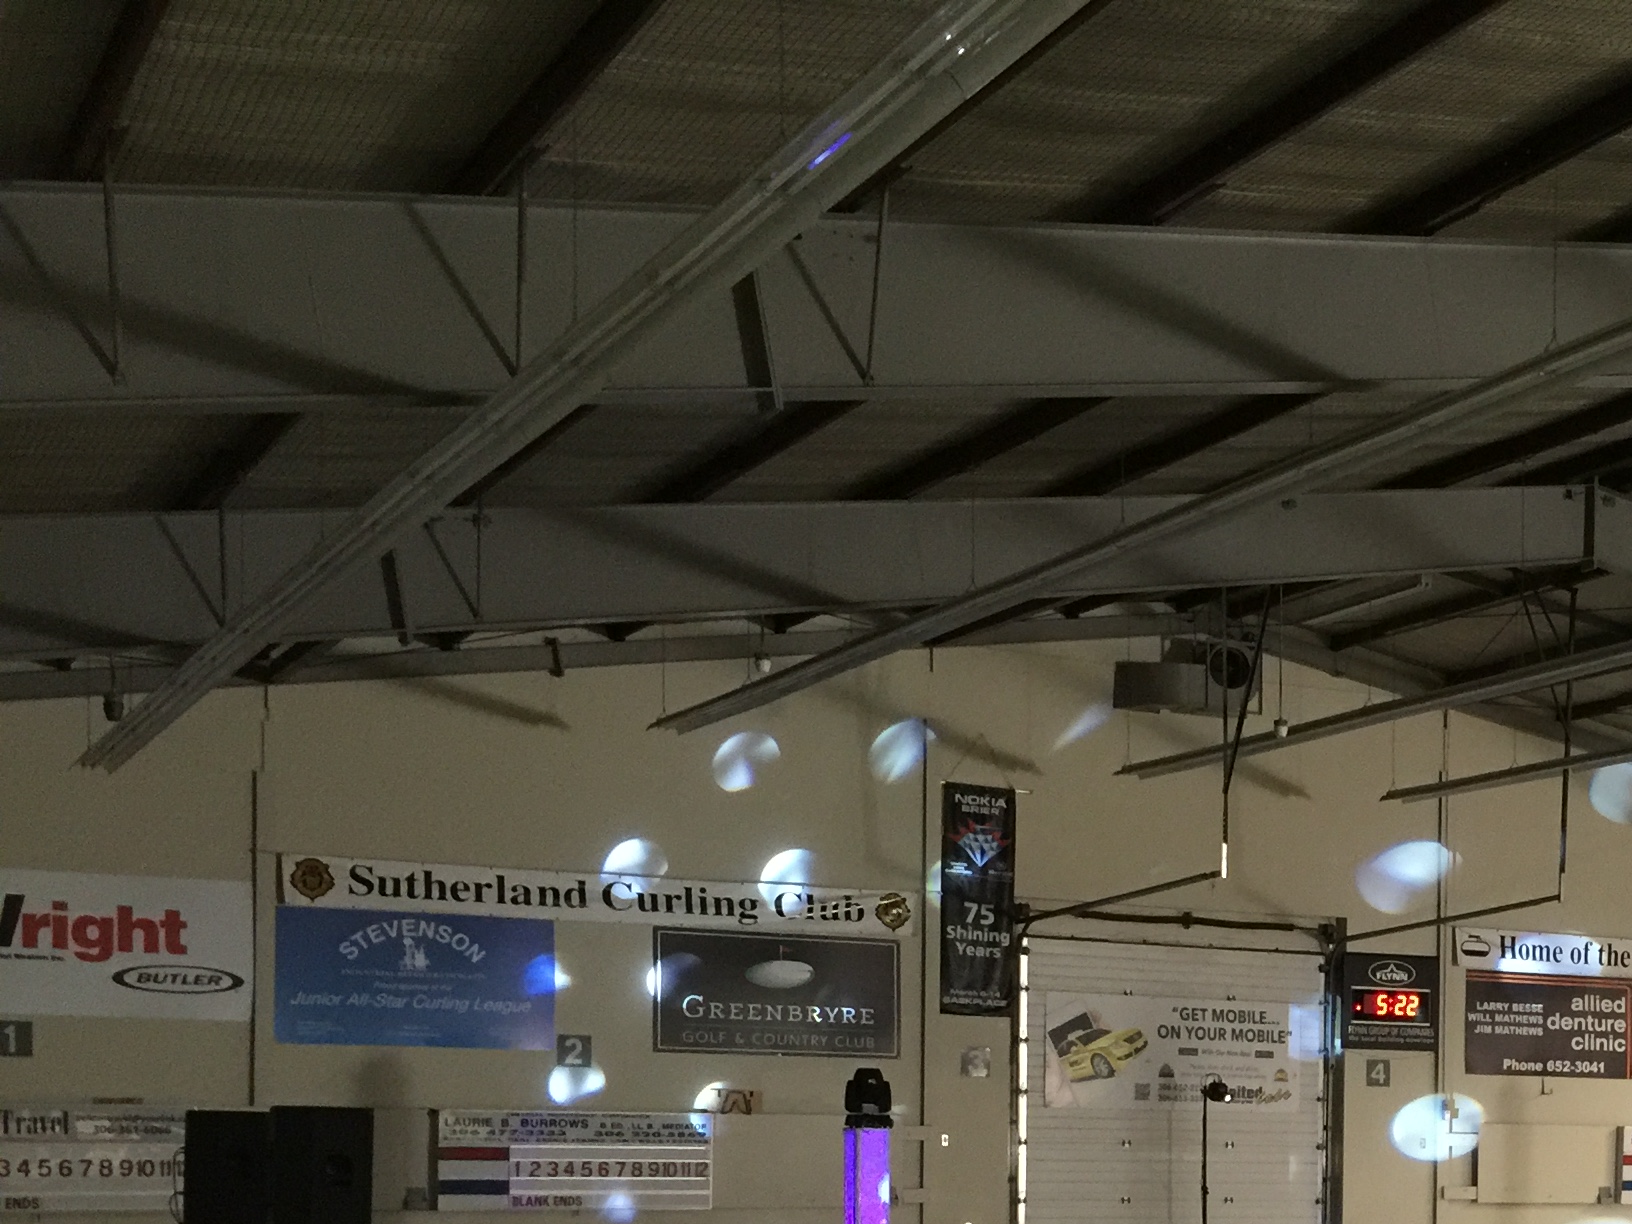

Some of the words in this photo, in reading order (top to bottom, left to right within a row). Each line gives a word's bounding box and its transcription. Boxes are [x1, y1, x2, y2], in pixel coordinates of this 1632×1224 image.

[955, 794, 1007, 808] NOKIA
[962, 805, 1000, 816] BRIER
[348, 864, 588, 909] Sutherland
[601, 881, 759, 925] Curling
[773, 891, 866, 923] Club
[964, 901, 995, 925] 75
[339, 919, 487, 963] STEVENSON
[946, 925, 1010, 947] Shining
[955, 941, 1001, 958] Years
[1500, 935, 1563, 963] Home
[1570, 942, 1594, 965] of
[1598, 943, 1631, 969] the
[136, 972, 223, 986] BUTLER
[1376, 971, 1408, 981] FLYNN
[290, 992, 343, 1006] Junior
[413, 994, 470, 1014] Curling
[474, 997, 532, 1015] League
[682, 995, 875, 1025] GREENBRYRE
[1377, 994, 1419, 1016] 5:22
[1476, 1001, 1508, 1012] LARRY
[1512, 1003, 1543, 1013] BESSE
[1571, 994, 1626, 1013] allied
[1467, 1013, 1492, 1022] WILL
[1495, 1014, 1543, 1024] MATHEWS
[1547, 1012, 1626, 1033] denture
[3, 1024, 16, 1053] 1
[1157, 1024, 1181, 1040] ON
[1185, 1026, 1227, 1041] YOUR
[1474, 1025, 1492, 1034] JIM
[1495, 1026, 1543, 1036] MATHEWS
[682, 1031, 726, 1044] GOLF
[735, 1032, 745, 1044] &
[752, 1033, 828, 1047] COUNTRY
[835, 1036, 875, 1048] CLUB
[1571, 1034, 1626, 1052] clinic
[564, 1038, 583, 1065] 2
[1371, 1062, 1385, 1084] 4
[1503, 1058, 1543, 1072] Phone
[1547, 1060, 1604, 1073] 652-3041
[1227, 1086, 1262, 1099] nited
[445, 1117, 493, 1128] LAURIE
[521, 1118, 589, 1129] BURROWS
[17, 1160, 30, 1177] 4
[38, 1160, 51, 1177] 5
[59, 1160, 72, 1177] 6
[78, 1160, 93, 1177] 7
[100, 1160, 113, 1177] 8
[120, 1160, 133, 1177] 9
[136, 1160, 155, 1177] 10
[160, 1160, 171, 1177] 11
[529, 1161, 541, 1177] 2
[547, 1161, 558, 1177] 3
[564, 1161, 575, 1177] 4
[580, 1161, 592, 1177] 5
[598, 1161, 609, 1177] 6
[615, 1161, 626, 1177] 7
[631, 1161, 643, 1177] 8
[648, 1161, 660, 1177] 9
[662, 1161, 677, 1177] 10
[681, 1161, 691, 1177] 11
[695, 1161, 708, 1177] 12
[5, 1198, 40, 1209] ENDS
[512, 1196, 550, 1207] BLANK
[554, 1196, 582, 1207] ENDS
